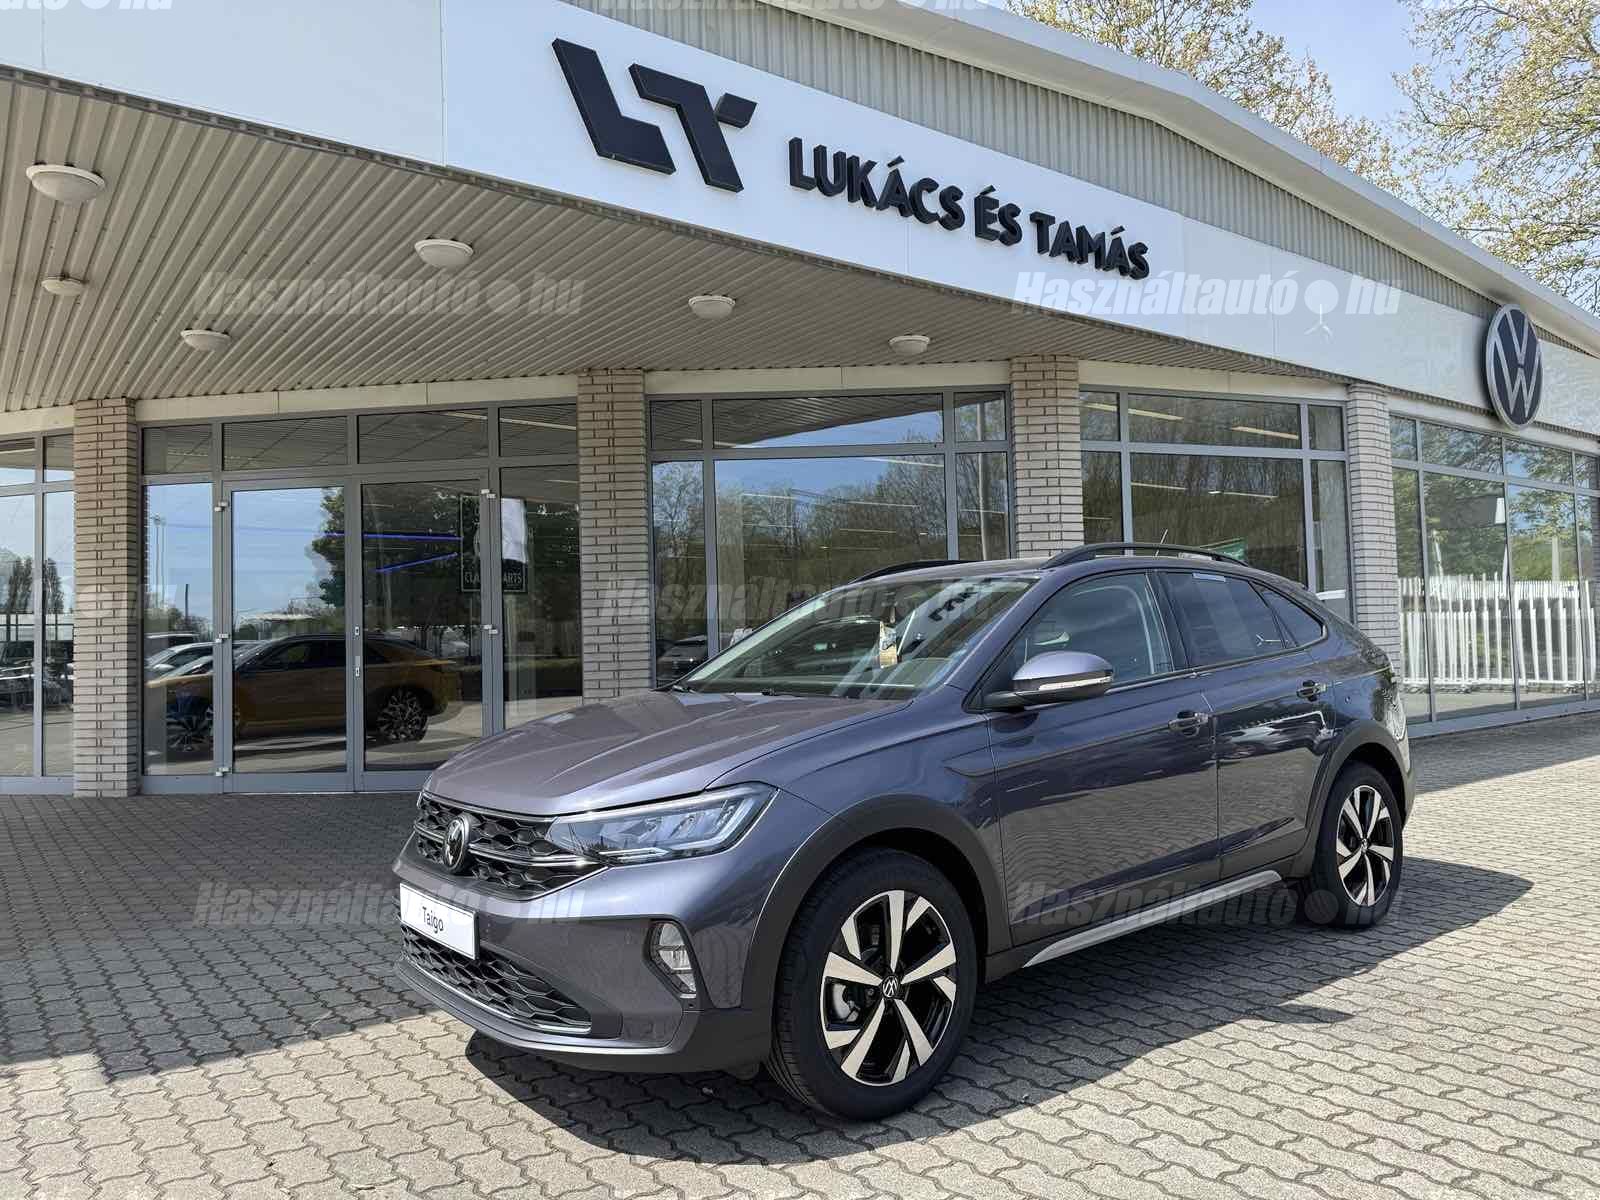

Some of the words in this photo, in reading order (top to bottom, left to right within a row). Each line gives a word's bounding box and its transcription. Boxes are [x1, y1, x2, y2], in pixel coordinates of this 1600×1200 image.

[788, 136, 966, 231] LUKÁCS
[973, 184, 1024, 247] ÉS
[1029, 210, 1151, 281] TAMÁS
[422, 906, 444, 934] Taigo
